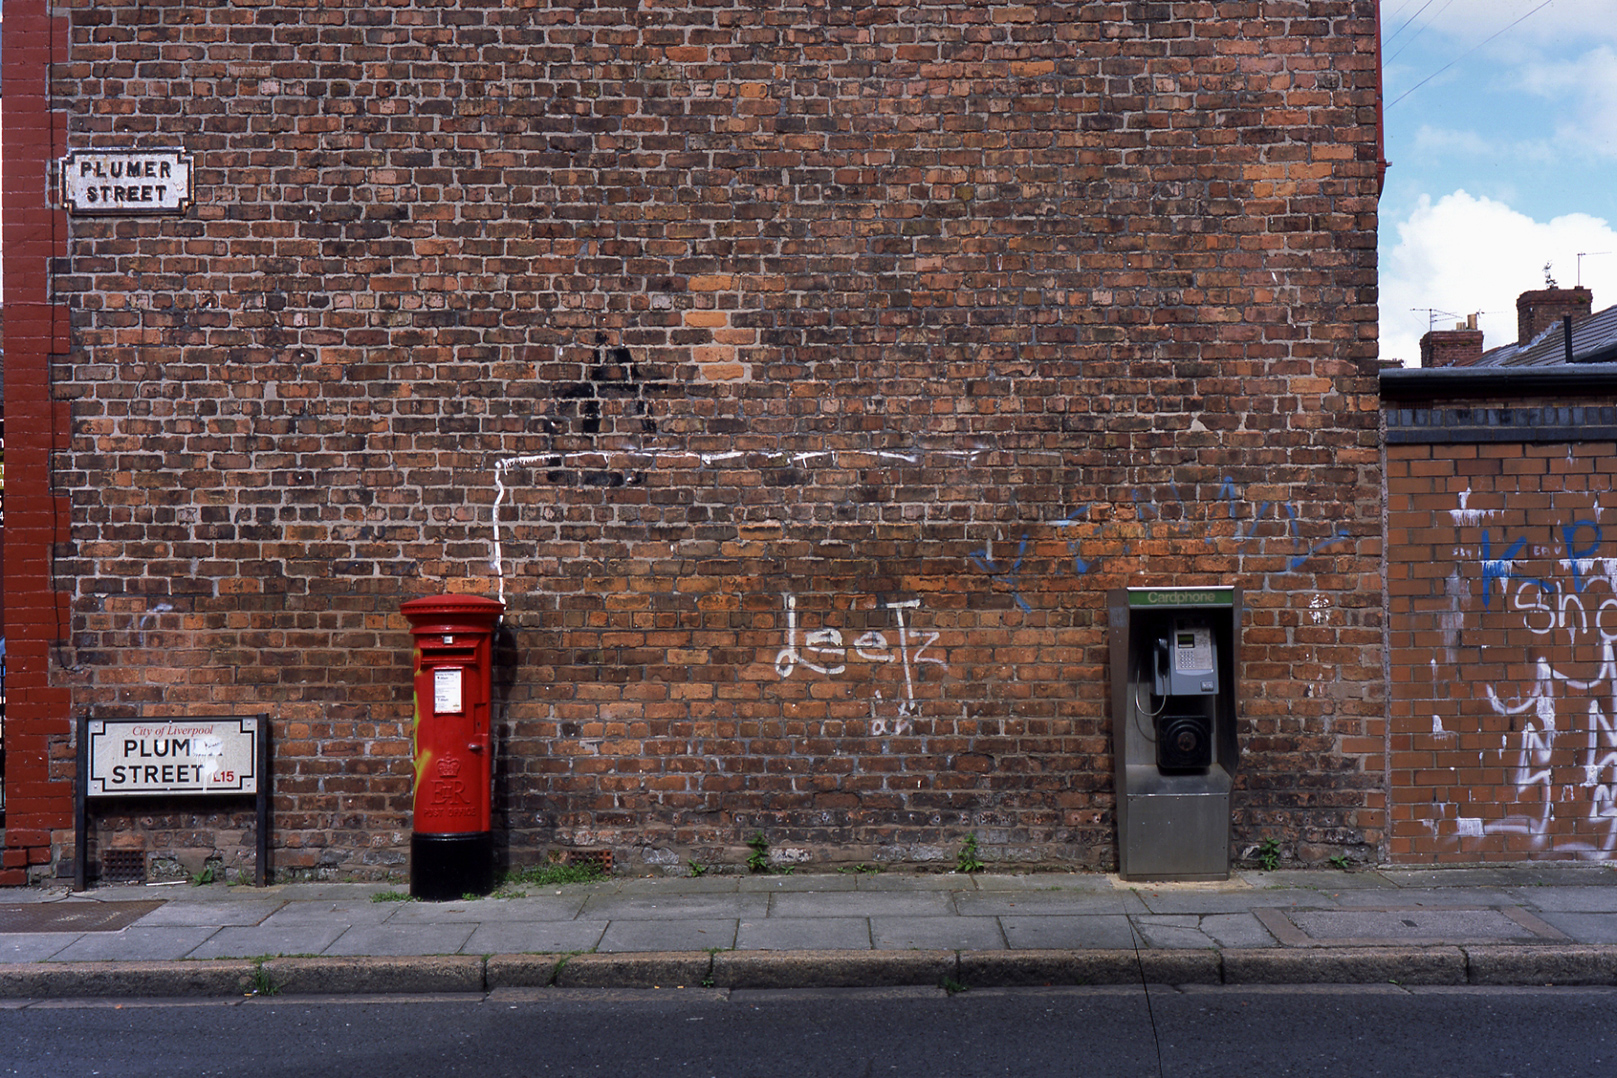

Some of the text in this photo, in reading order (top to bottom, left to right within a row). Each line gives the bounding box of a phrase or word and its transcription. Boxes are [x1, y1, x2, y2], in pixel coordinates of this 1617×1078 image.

[80, 161, 172, 178] PLUMER
[86, 185, 167, 202] STREET
[1147, 591, 1216, 605] Cardphone
[132, 725, 214, 738] City of Liverpool
[112, 765, 235, 783] STREET L15
[423, 807, 476, 818] POST OFFICE
